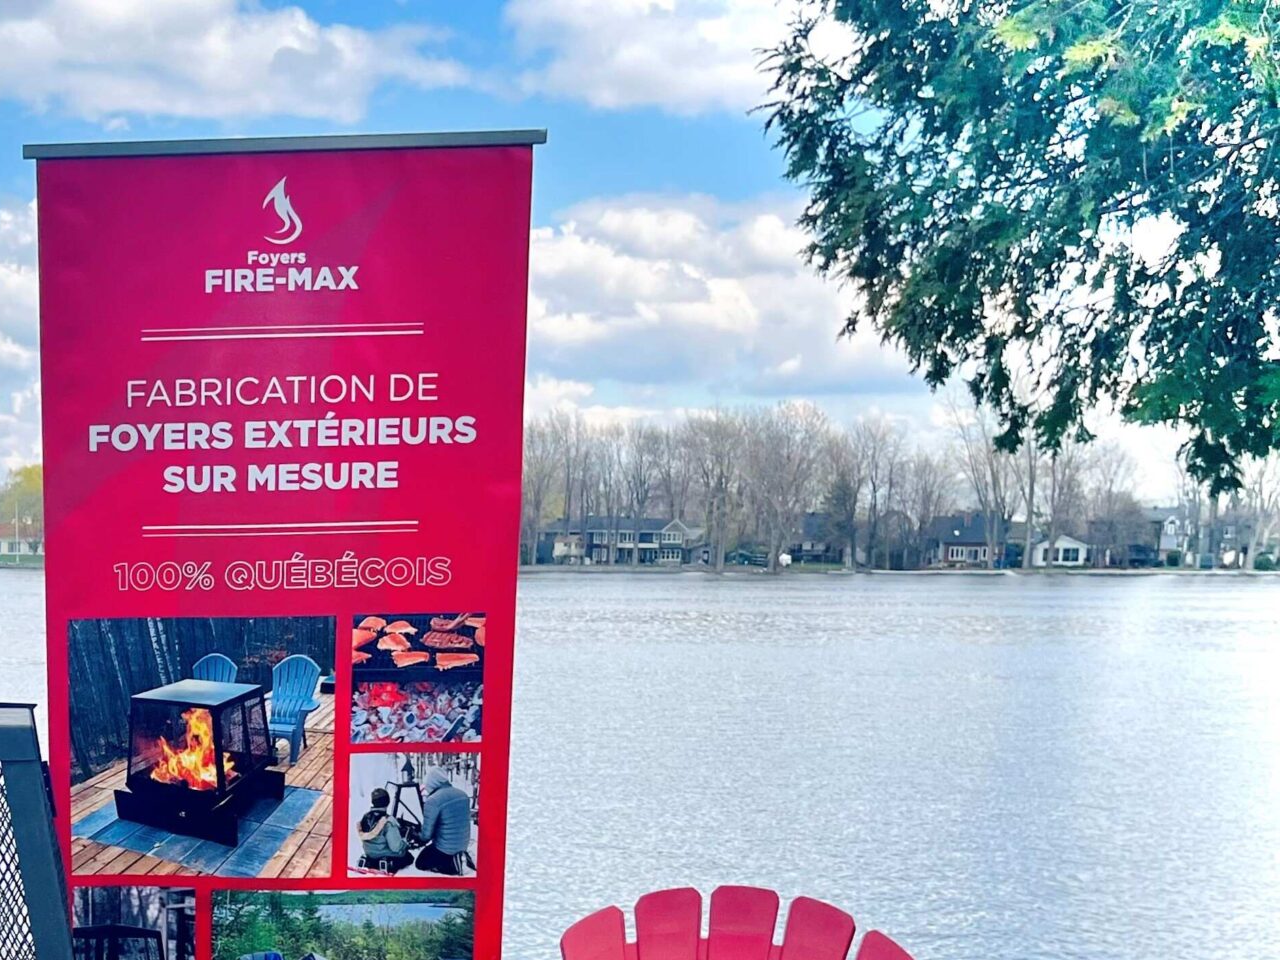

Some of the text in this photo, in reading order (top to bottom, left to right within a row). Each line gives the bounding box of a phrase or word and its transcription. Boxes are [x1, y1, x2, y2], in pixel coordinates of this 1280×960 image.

[247, 250, 307, 266] Foyers
[205, 265, 359, 293] FIRE-MAX
[126, 373, 439, 408] FABRICATION DE
[88, 411, 477, 452] FOYERS EXTÉRIEURS
[163, 462, 399, 493] SUR MESURE
[113, 551, 452, 591] 100% QUÉBÉCOIS
